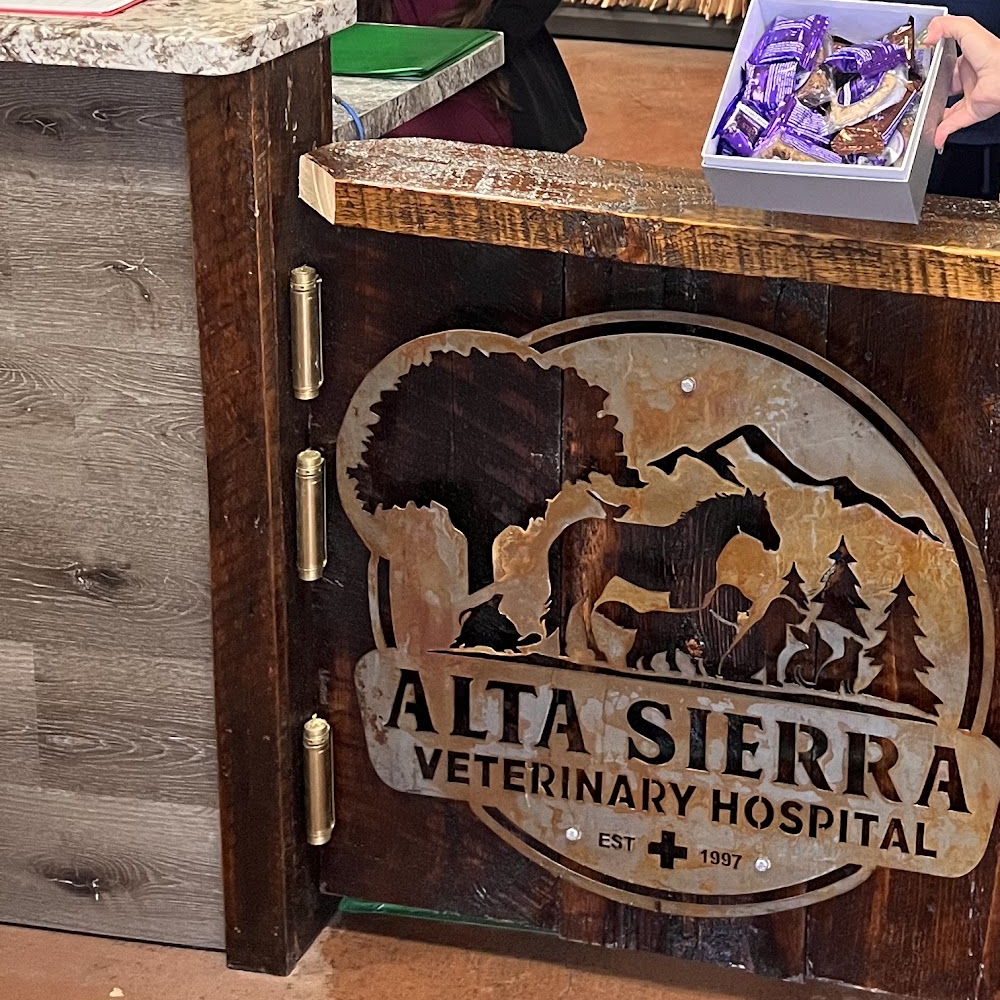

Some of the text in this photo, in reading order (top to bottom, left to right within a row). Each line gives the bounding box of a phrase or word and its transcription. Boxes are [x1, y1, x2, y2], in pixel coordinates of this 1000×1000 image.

[383, 668, 973, 815] ALTA SIERRA
[414, 745, 939, 859] VETERINARY HOSPITAL
[598, 831, 743, 870] EST 1997
